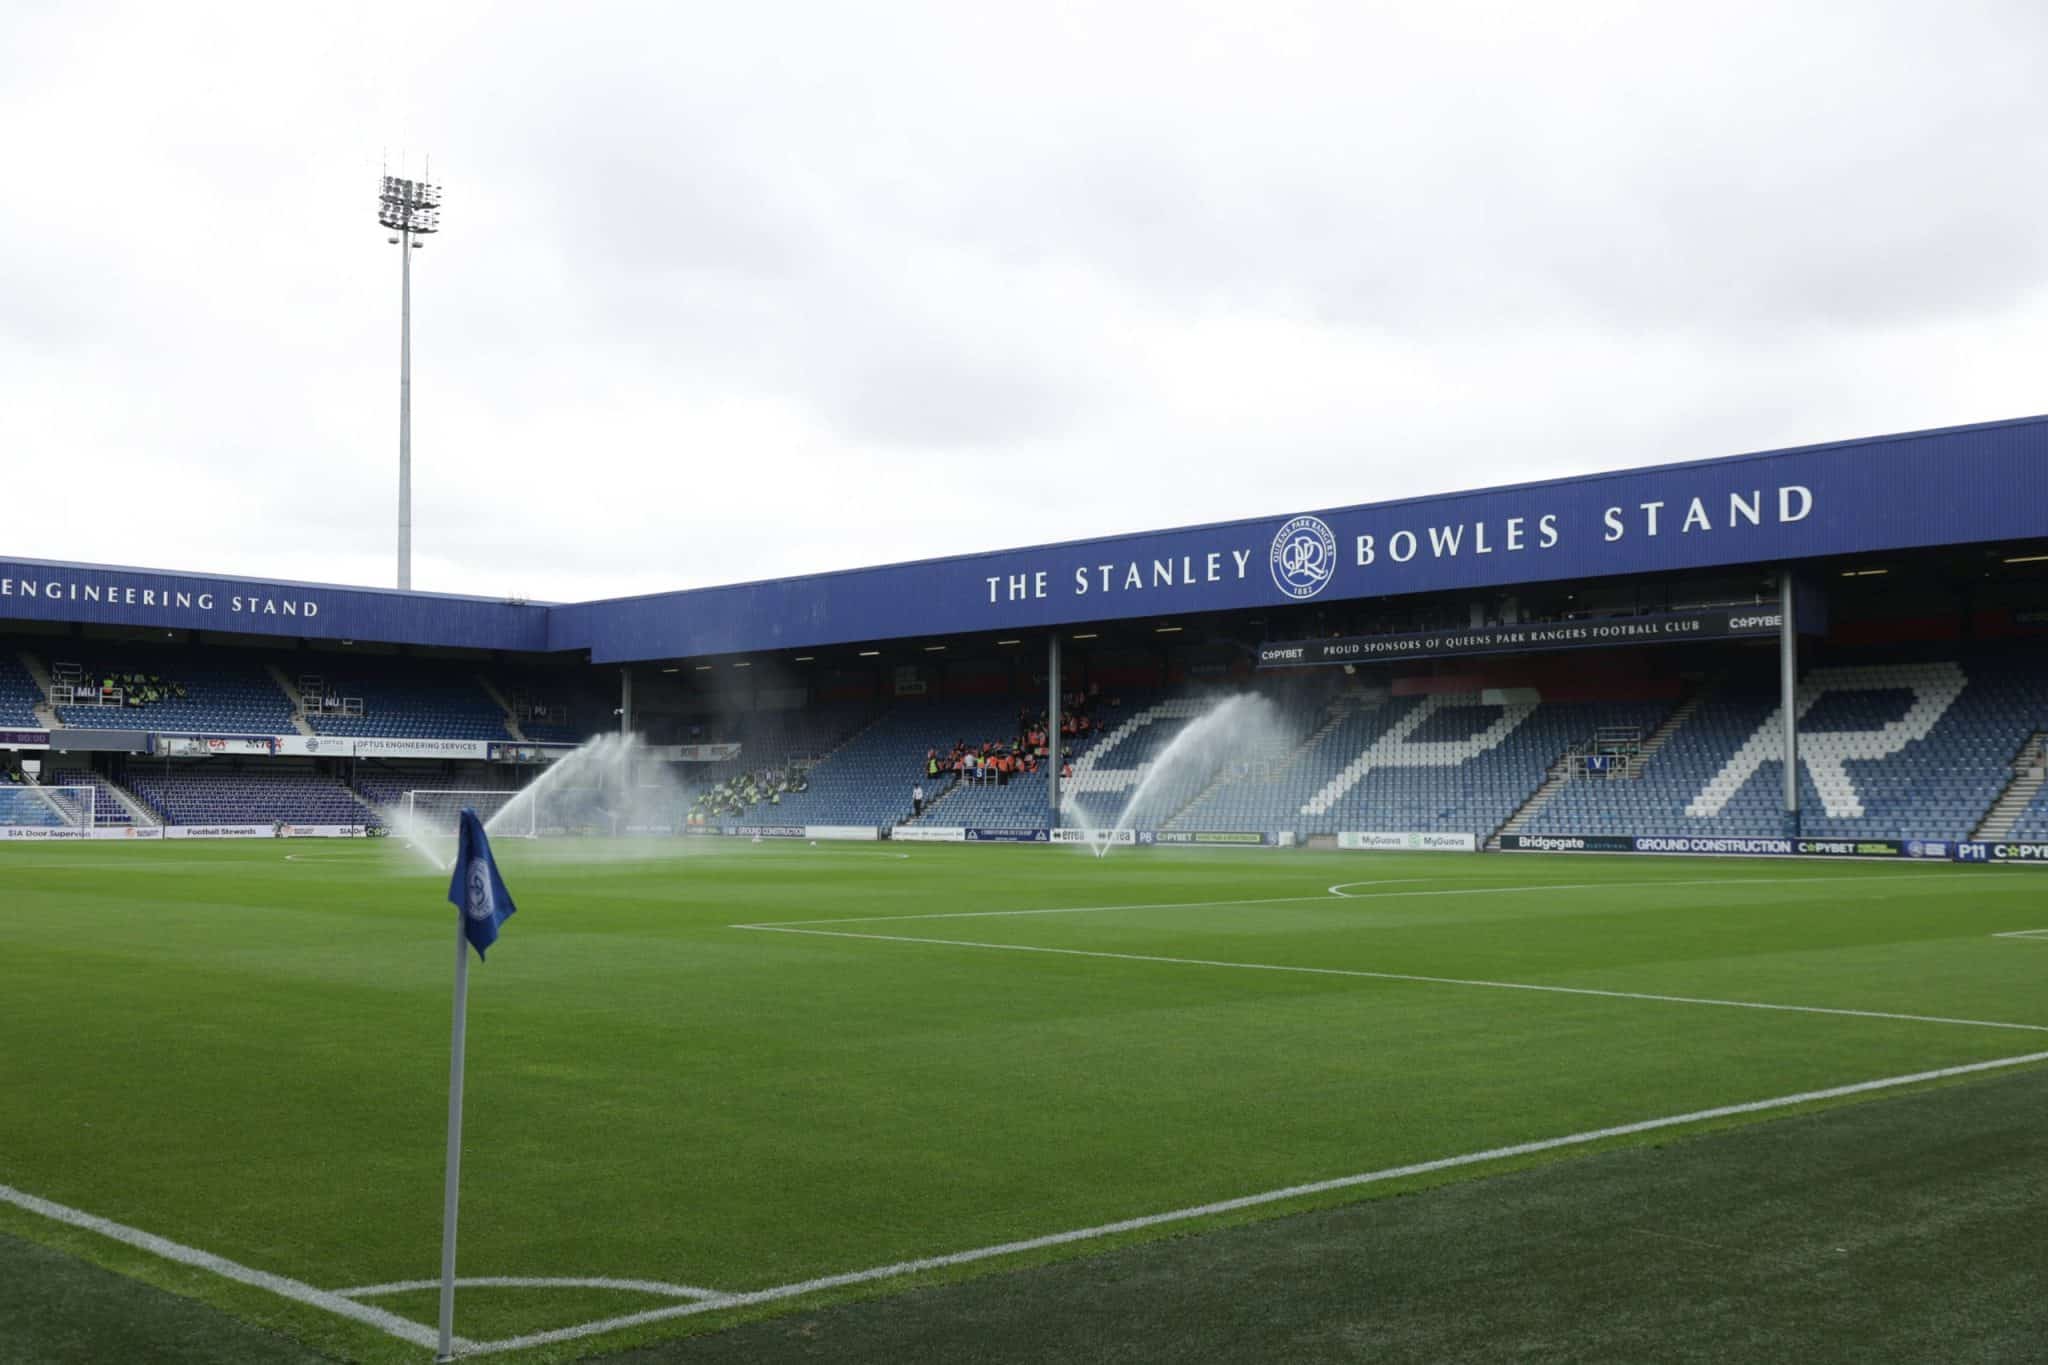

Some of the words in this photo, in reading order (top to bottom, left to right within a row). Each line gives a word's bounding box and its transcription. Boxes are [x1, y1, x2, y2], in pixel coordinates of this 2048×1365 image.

[986, 571, 1048, 603] THE
[1075, 549, 1251, 594] STANLEY
[1356, 514, 1559, 566] BOWLES
[1604, 485, 1813, 542] STAND
[1273, 527, 1291, 562] QUEENS
[1291, 520, 1310, 530] PARK
[1311, 521, 1333, 557] RANGERS
[2, 578, 214, 610] ENGINEERING
[232, 596, 319, 617] STAND
[1729, 615, 1783, 629] COPYBE
[1323, 644, 1359, 655] PROUD
[1364, 639, 1421, 653] SPONSORS
[1426, 637, 1442, 649] OF
[1446, 635, 1491, 648] QUEENS
[1496, 632, 1525, 643] PARK
[1531, 628, 1587, 641] RANGERS
[1593, 623, 1659, 637] FOOTBALL
[1665, 620, 1700, 633] CLUB
[355, 741, 384, 749] OFTUS
[386, 742, 440, 750] ENGINEERING
[441, 743, 477, 751] SERVICES
[1593, 757, 1603, 769] V
[8, 829, 23, 837] SIA
[187, 828, 220, 836] Football
[221, 828, 256, 836] Stewards
[1424, 837, 1464, 846] MyGuava
[1519, 836, 1584, 849] Bridgegate
[1636, 838, 1689, 850] GROUND
[1691, 840, 1790, 853] CONSTRUCTION
[1959, 844, 1985, 858] P11
